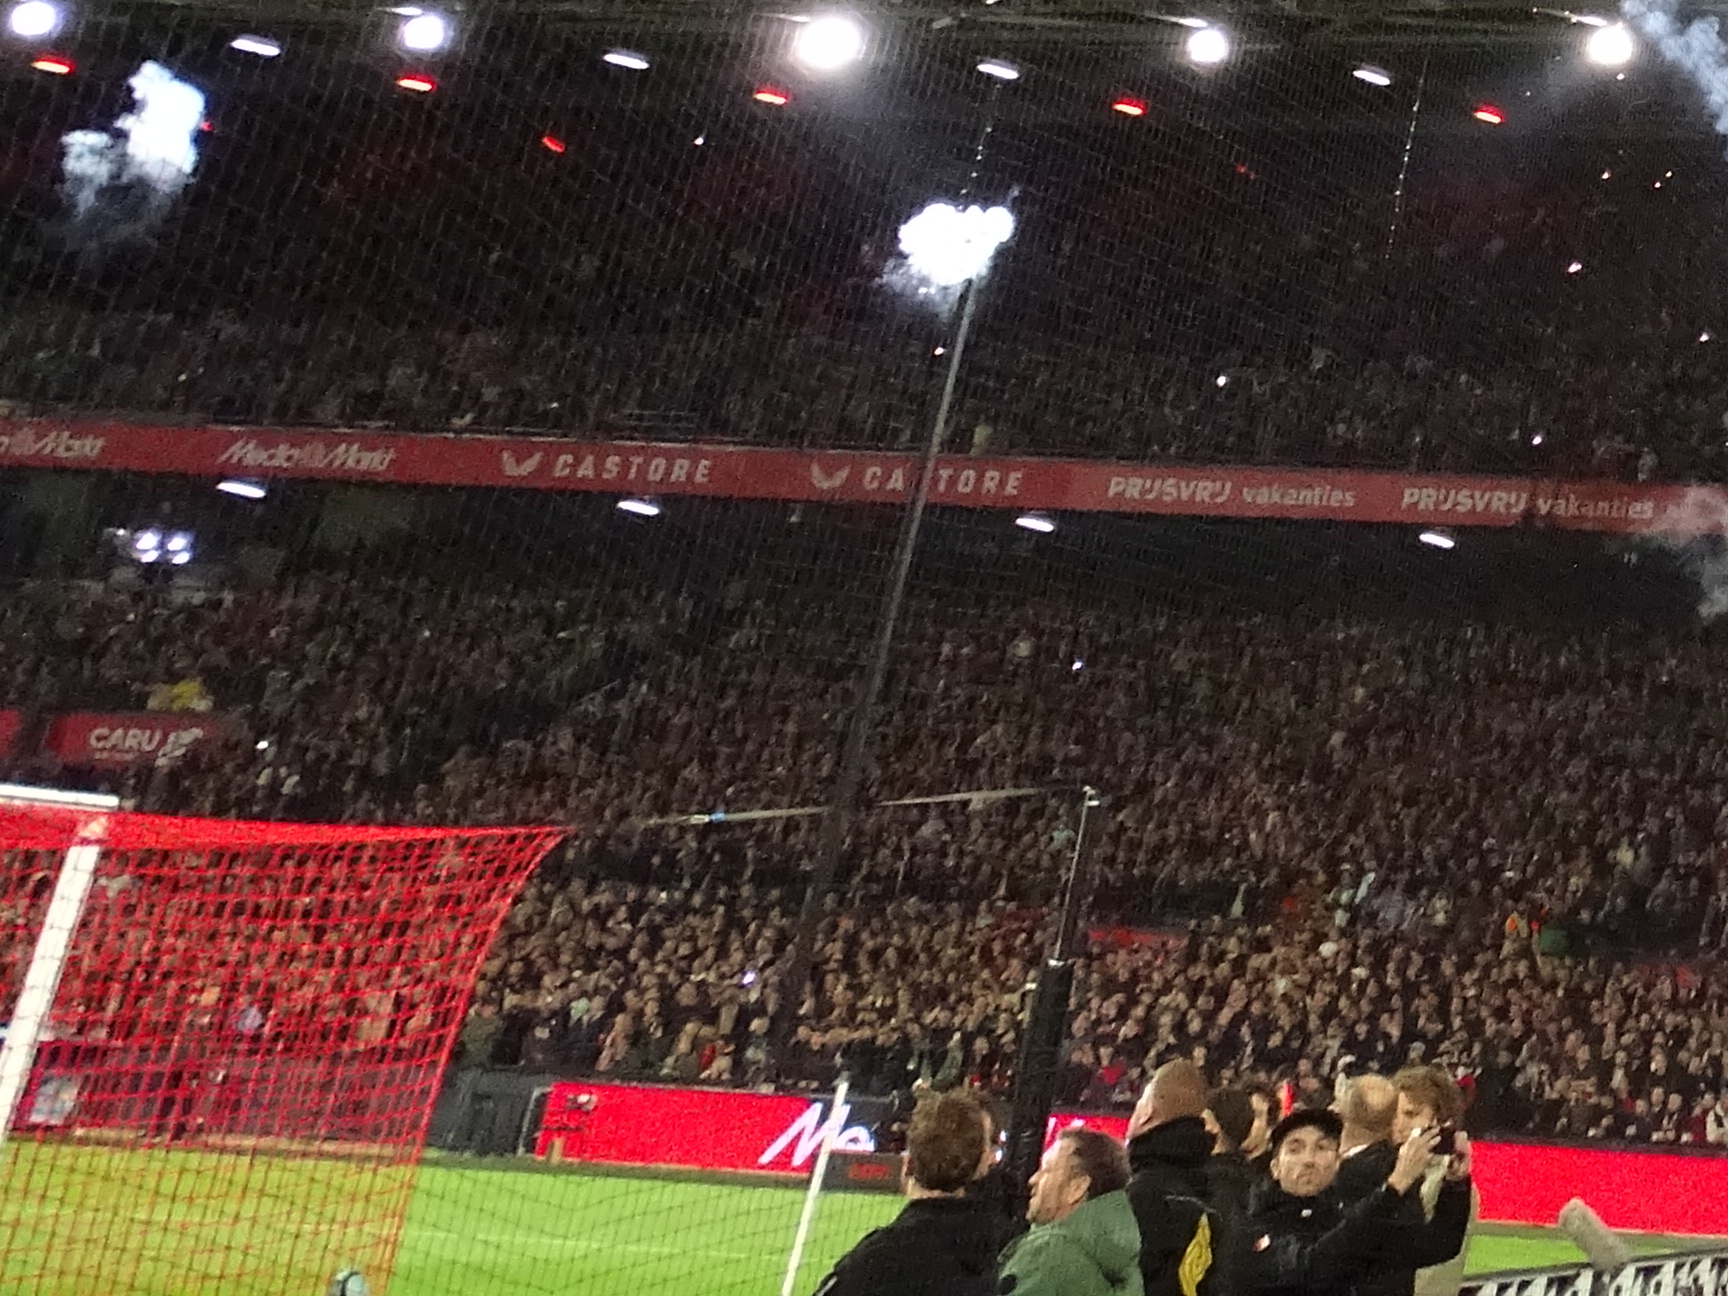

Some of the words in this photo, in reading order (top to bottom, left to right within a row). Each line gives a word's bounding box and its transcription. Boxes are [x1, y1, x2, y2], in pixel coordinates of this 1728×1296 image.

[551, 453, 713, 485] CASTORE
[862, 464, 1024, 497] CATORE
[1242, 483, 1358, 508] vakanties
[1536, 495, 1655, 520] vakanties
[89, 726, 163, 753] CARU
